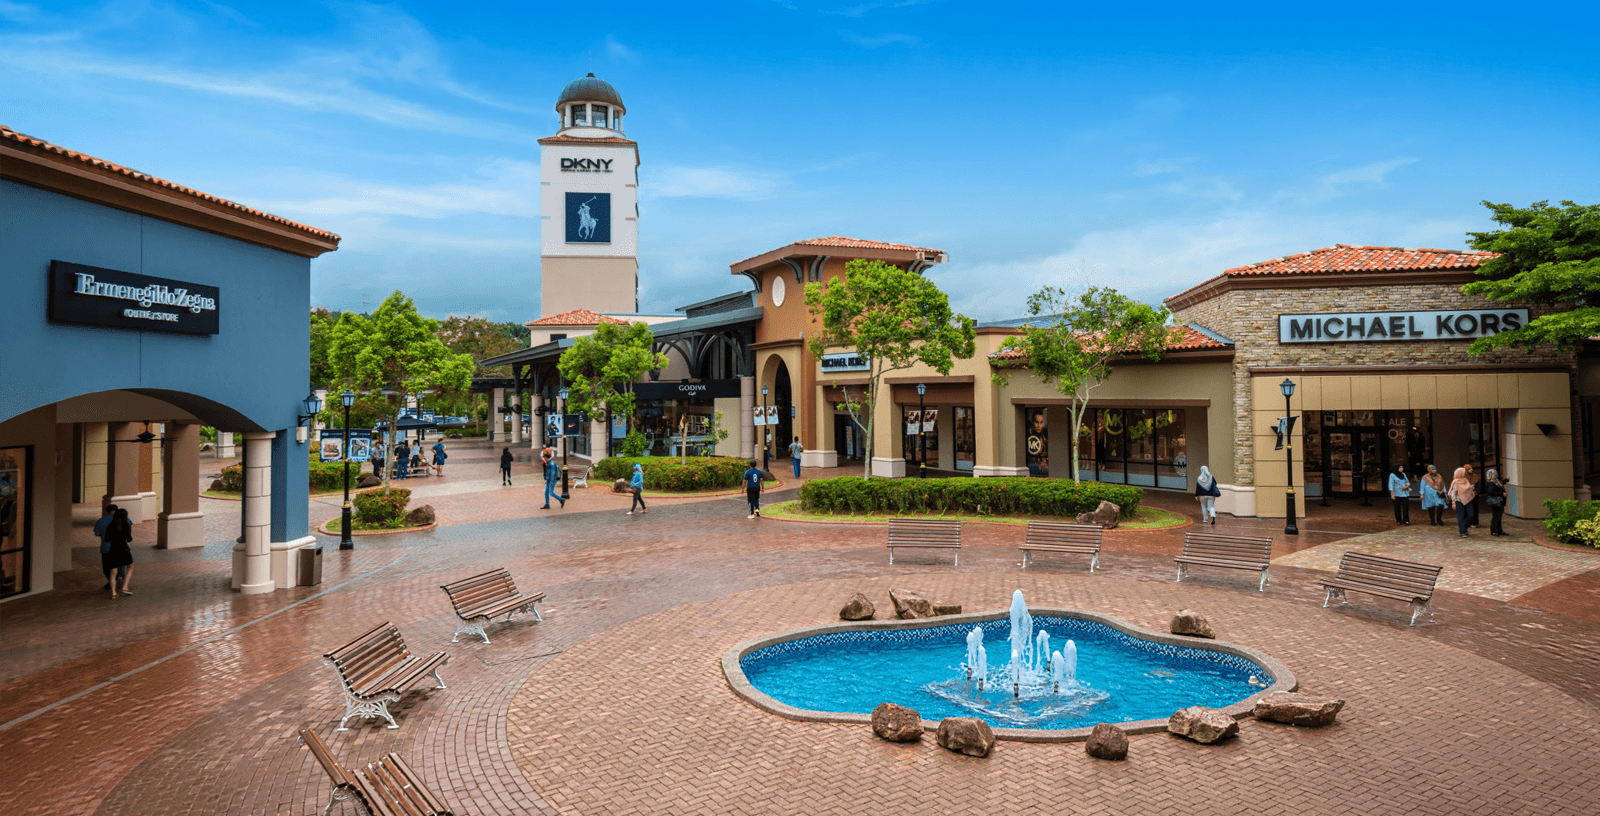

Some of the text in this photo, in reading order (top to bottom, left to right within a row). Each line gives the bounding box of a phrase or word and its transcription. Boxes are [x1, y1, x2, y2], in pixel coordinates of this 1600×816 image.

[561, 158, 613, 169] DKNY
[1290, 312, 1522, 339] MICHAEL KORS
[678, 384, 707, 392] GODIVA
